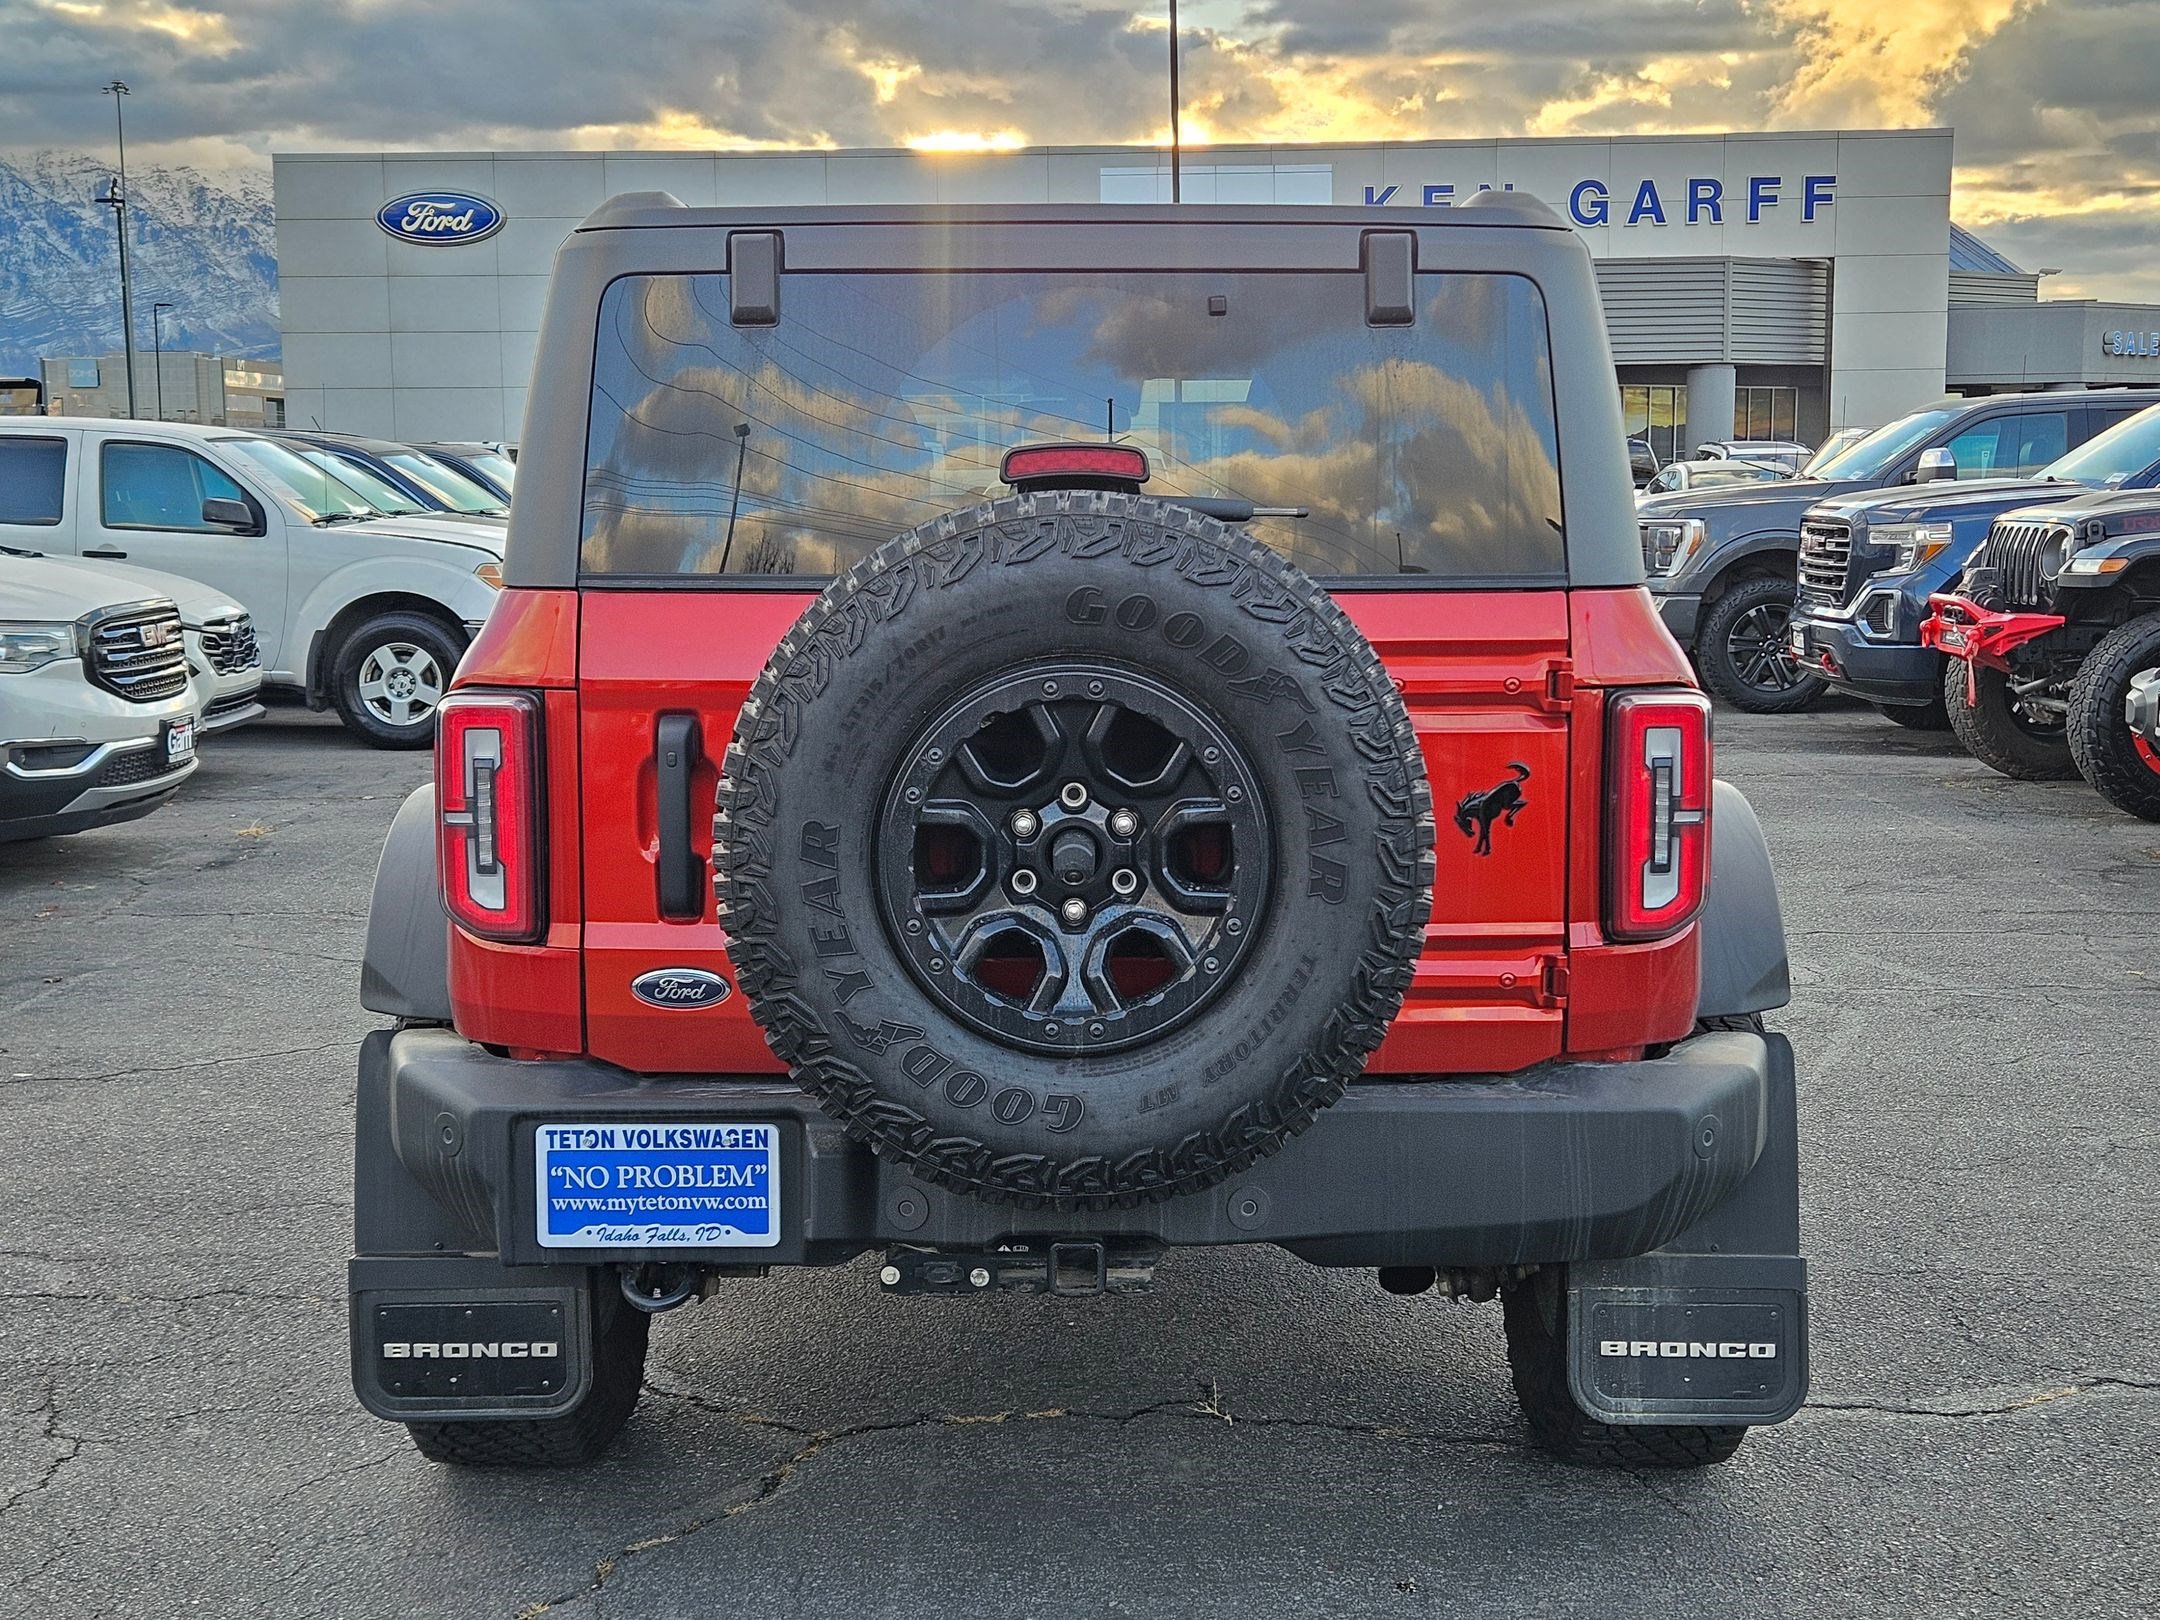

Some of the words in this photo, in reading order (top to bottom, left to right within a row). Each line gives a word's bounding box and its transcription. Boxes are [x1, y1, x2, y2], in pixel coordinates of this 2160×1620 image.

[1568, 174, 1838, 227] GARFF
[401, 201, 474, 232] Ford
[654, 977, 707, 999] Ford
[1202, 954, 1317, 1089] TERRITORY
[545, 1129, 615, 1149] TETON
[622, 1128, 769, 1149] VOLKSWAGEN
[551, 1194, 768, 1216] www.mytetonvw.com
[596, 1226, 640, 1242] Idaho
[695, 1226, 722, 1241] ID
[383, 1342, 558, 1358] BRONCO
[1600, 1341, 1776, 1358] BRONCO
